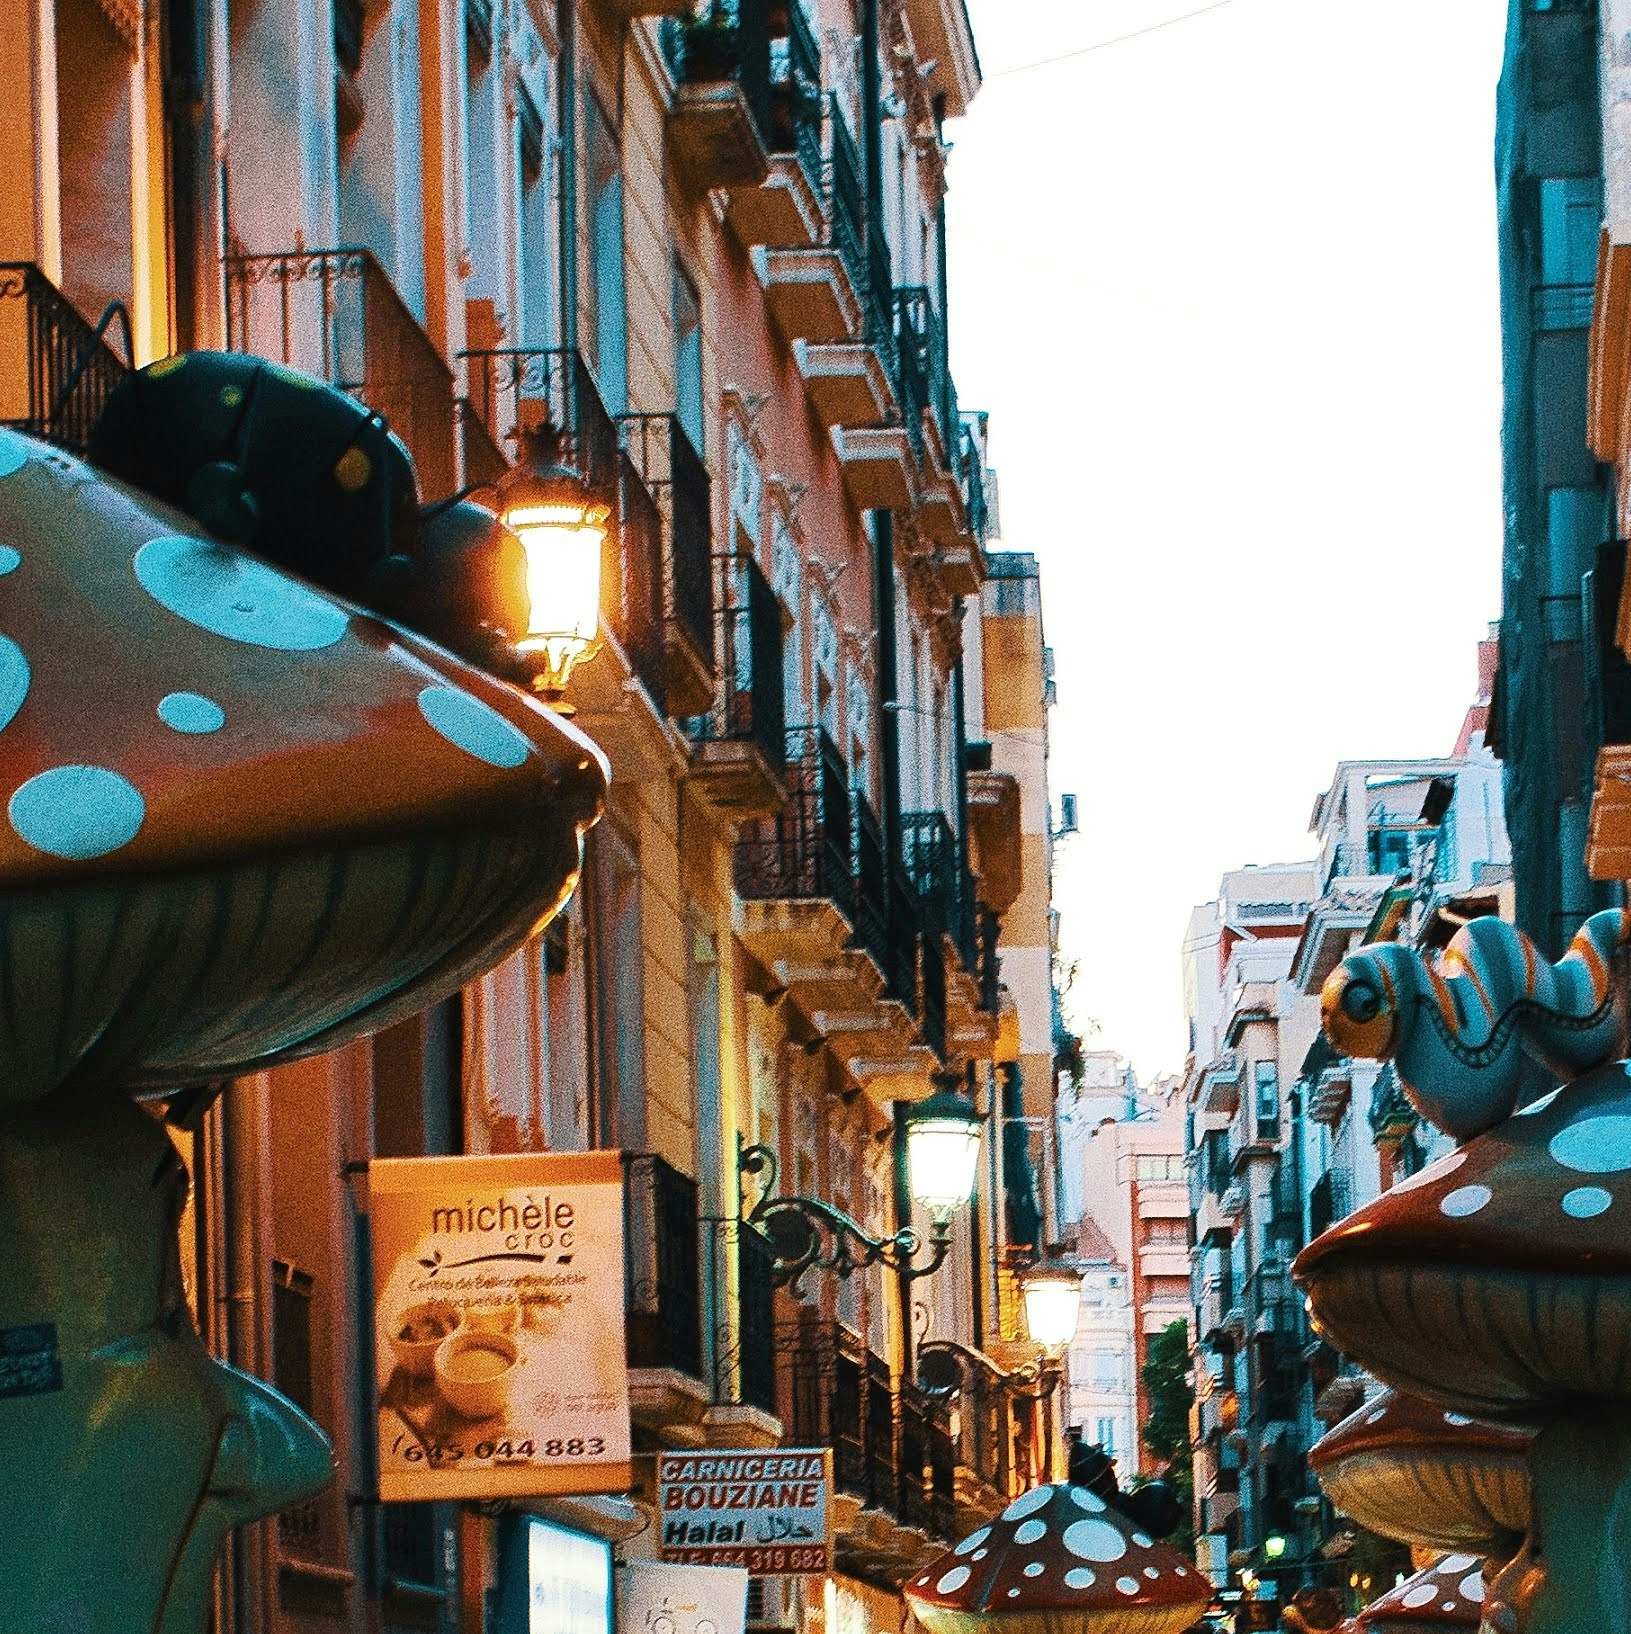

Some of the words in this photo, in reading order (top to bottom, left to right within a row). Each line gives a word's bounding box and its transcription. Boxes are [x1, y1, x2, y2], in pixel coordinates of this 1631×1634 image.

[431, 1194, 575, 1234] michèle
[504, 1231, 575, 1250] croc
[474, 1438, 536, 1460] 044
[545, 1437, 606, 1457] 883
[662, 1458, 824, 1481] CARNICERIA
[664, 1483, 819, 1511] BOUZIANE
[664, 1520, 745, 1545] Halal
